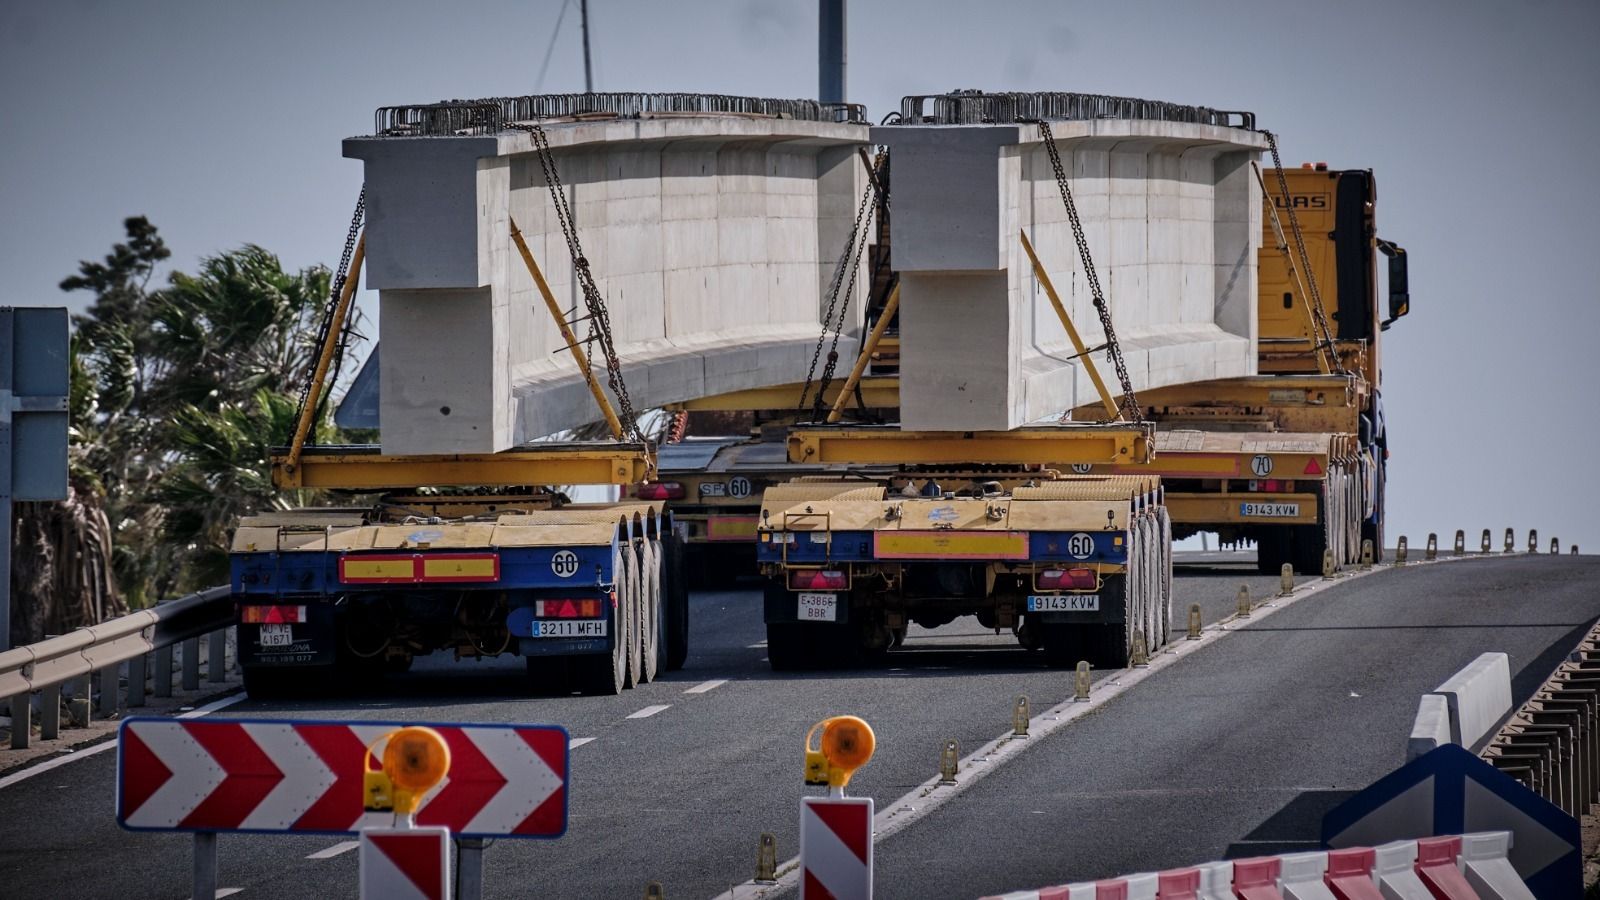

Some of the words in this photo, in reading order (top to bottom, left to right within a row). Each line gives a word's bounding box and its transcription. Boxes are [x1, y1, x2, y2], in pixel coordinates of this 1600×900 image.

[1255, 456, 1271, 474] 70
[731, 479, 748, 496] 60
[1246, 504, 1273, 515] 9143
[1275, 504, 1296, 516] KVM
[1071, 536, 1091, 556] 60
[554, 553, 575, 574] 60
[1035, 597, 1068, 610] 9143
[1071, 597, 1095, 610] KVM
[541, 622, 572, 635] 3211
[577, 622, 602, 635] MFH
